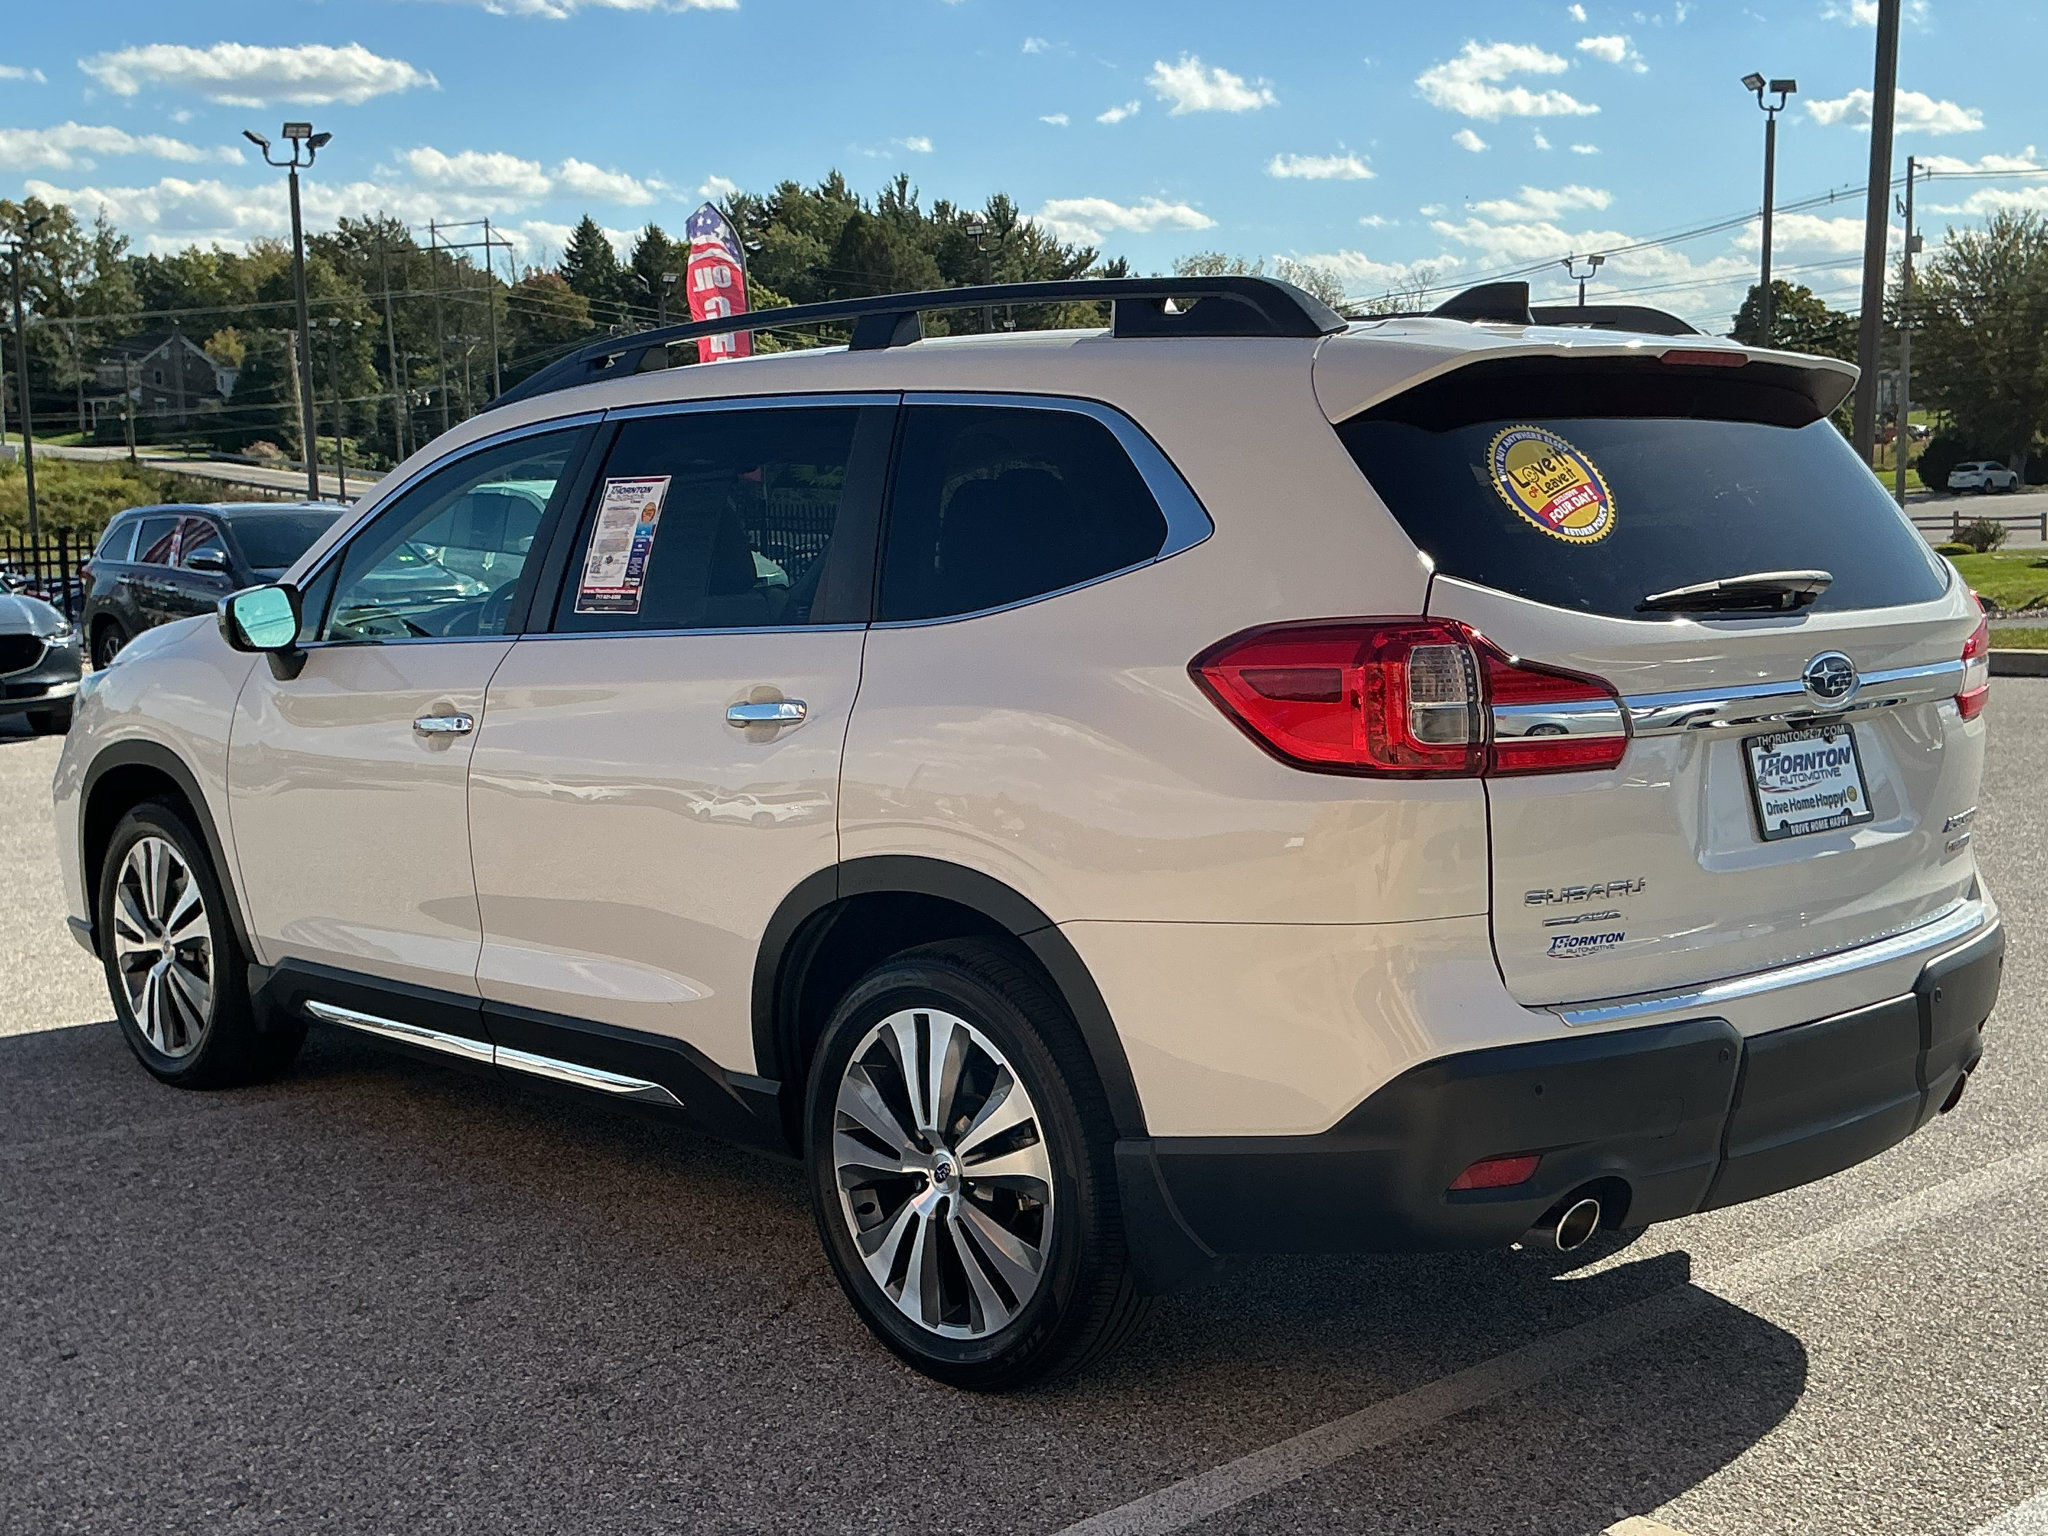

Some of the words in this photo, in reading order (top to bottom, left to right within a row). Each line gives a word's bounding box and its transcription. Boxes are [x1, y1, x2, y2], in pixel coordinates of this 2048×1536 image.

[1502, 431, 1542, 448] ANYWHERE
[1544, 435, 1568, 452] ELSE?
[1495, 445, 1507, 461] BUY
[1547, 447, 1569, 467] it
[1495, 462, 1508, 482] WHY
[1536, 473, 1569, 494] Leave
[1562, 467, 1577, 480] it
[1548, 500, 1576, 524] FOUR
[1563, 525, 1596, 536] RETURN
[1592, 505, 1608, 531] POLICY
[1757, 746, 1852, 777] THORNTON
[1780, 767, 1842, 786] AUTOMOTIVE
[1766, 800, 1789, 816] Drive
[1789, 796, 1816, 813] Home
[1816, 788, 1848, 809] Happy!
[1790, 823, 1811, 836] DRIVE
[1810, 819, 1830, 833] HOME
[1829, 814, 1849, 829] HAPPY
[1524, 877, 1646, 907] SUBARU
[1550, 931, 1626, 950] THORNTON
[1566, 943, 1616, 954] AUTOMOTIVE
